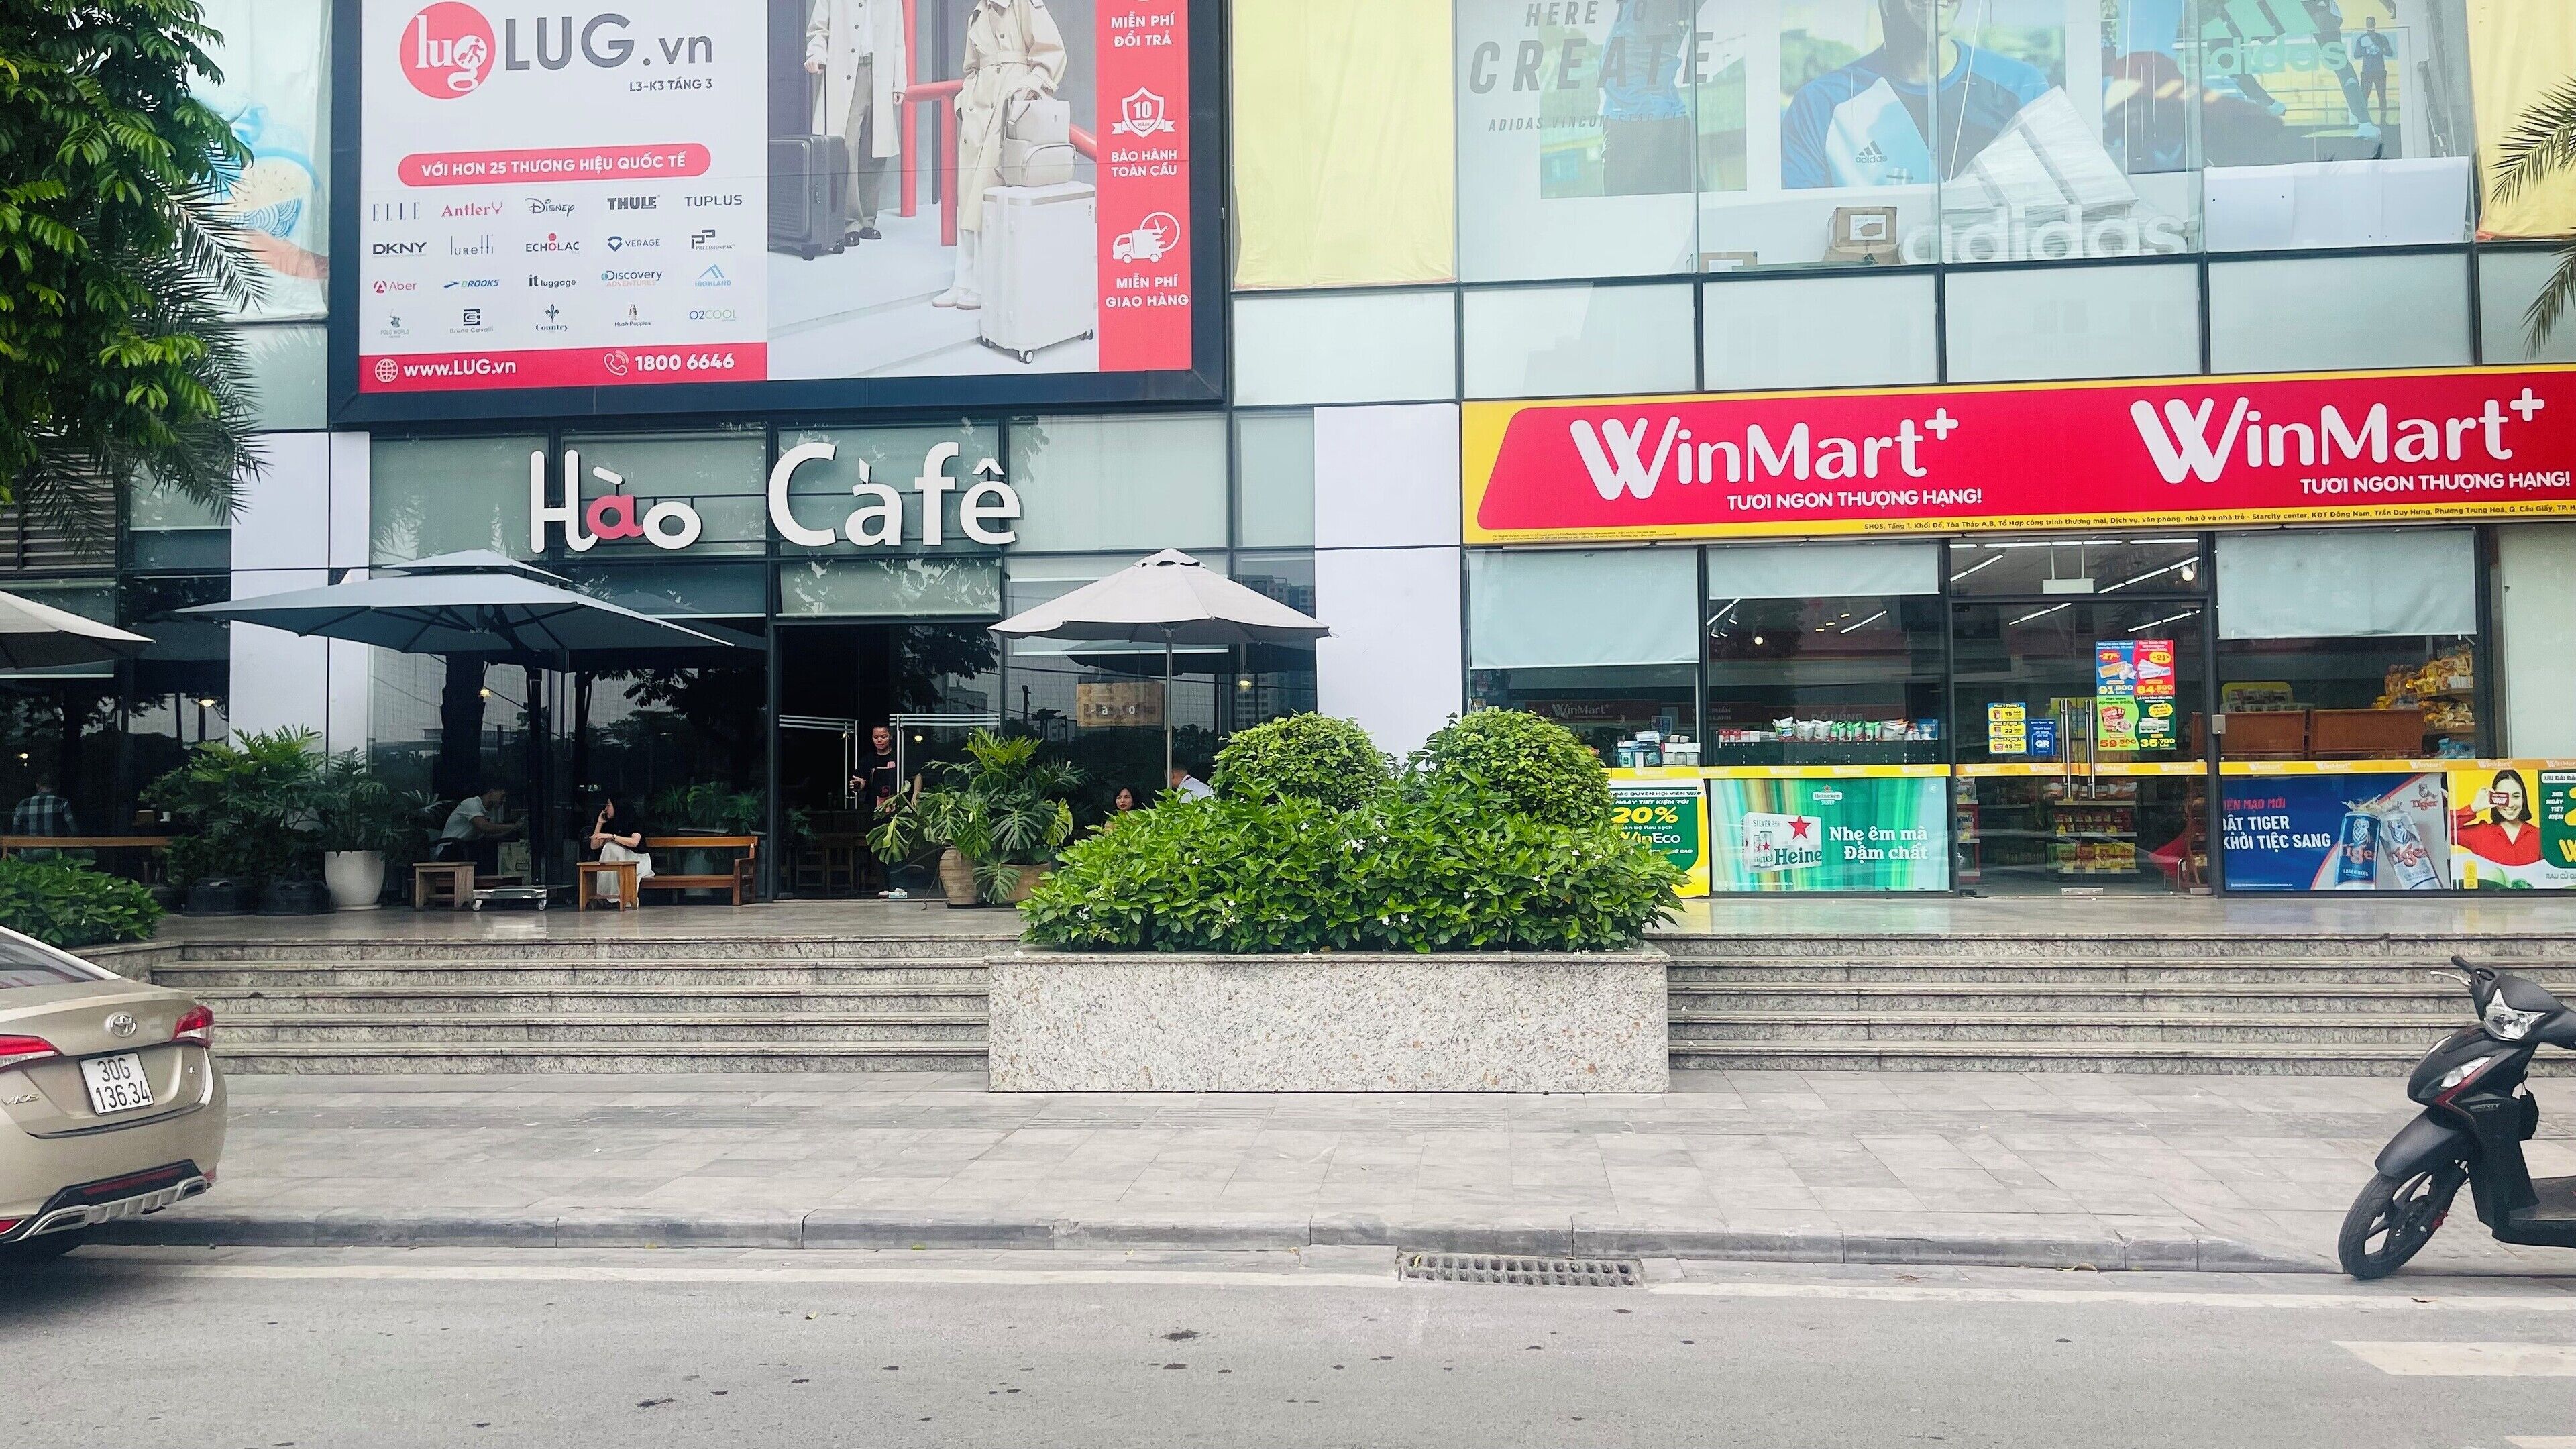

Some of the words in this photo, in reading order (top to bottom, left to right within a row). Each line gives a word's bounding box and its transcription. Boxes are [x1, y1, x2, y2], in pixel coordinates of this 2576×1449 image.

[1111, 11, 1146, 28] MIỄN
[1150, 11, 1175, 26] PHÍ
[1525, 0, 1598, 27] HERE
[1616, 0, 1646, 23] TO
[505, 13, 712, 70] LUG.vn
[1114, 30, 1140, 47] ĐỔI
[1144, 30, 1172, 46] TRẢ
[415, 14, 488, 92] lug
[1468, 31, 1715, 95] CREATE
[629, 80, 665, 92] L3-K3
[705, 78, 712, 89] 3
[1132, 101, 1152, 119] 10
[1488, 116, 1544, 132] ADIDAS
[1552, 114, 1609, 129] VINCOM
[1111, 148, 1139, 163] BẢO
[1142, 148, 1177, 161] HÀNH
[1855, 155, 1888, 163] adidas
[421, 163, 449, 177] VỚI
[452, 161, 486, 175] HƠN
[489, 160, 507, 174] 25
[511, 159, 576, 174] THƯƠNG
[580, 154, 613, 173] HIỆU
[617, 151, 664, 169] QUỐC
[668, 150, 687, 168] TẾ
[1111, 163, 1146, 177] TOÀN
[607, 196, 657, 210] THULE
[684, 195, 743, 207] TUPLUS
[372, 201, 420, 221] ELLE
[441, 202, 491, 217] Antler
[1901, 203, 2192, 264] adidas
[372, 241, 427, 255] DKNY
[525, 241, 580, 252] ECHOLAC
[625, 239, 661, 248] VERAGE
[461, 278, 500, 288] BROOKS
[529, 274, 539, 287] it
[541, 278, 576, 289] luggage
[606, 270, 663, 282] Discovery
[1116, 273, 1150, 288] MIỄN
[1155, 274, 1179, 287] PHÍ
[389, 281, 417, 292] Aber
[606, 280, 657, 288] ADVENTURES
[694, 280, 732, 288] HIGHLAND
[1106, 296, 1142, 307] GIAO
[1146, 292, 1189, 307] HÀNG
[535, 323, 569, 332] Country
[402, 358, 517, 378] www.LUG.vn
[635, 354, 682, 372] 1800
[686, 352, 736, 370] 6646
[2300, 476, 2348, 495] TƯƠI
[2353, 474, 2414, 494] NGON
[2418, 472, 2505, 493] THƯỢNG
[2509, 470, 2571, 492] HẠNG!
[530, 448, 703, 553] Hào
[1726, 493, 1772, 511] TƯƠI
[1776, 491, 1833, 509] NGON
[1837, 489, 1919, 510] THƯỢNG
[1922, 487, 1982, 508] HẠNG!
[2253, 513, 2282, 521] Starcity
[2330, 510, 2351, 519] Đông
[2394, 508, 2408, 517] Duy
[2434, 506, 2464, 515] Phường
[2035, 739, 2050, 747] QR
[1611, 806, 1678, 824] 20%
[2247, 815, 2290, 830] TIGER
[1753, 819, 1772, 828] SILVER
[1829, 826, 1867, 845] Nhẹ
[1868, 825, 1896, 841] êm
[1900, 825, 1928, 841] mà
[2256, 831, 2290, 853] TIỆC
[2292, 833, 2332, 849] SANG
[1774, 847, 1822, 866] Heine
[1844, 845, 1885, 864] Đậm
[1888, 841, 1928, 860] chất
[97, 1057, 131, 1083] 30G
[0, 1093, 40, 1106] VIOS
[95, 1080, 151, 1111] 136.34
